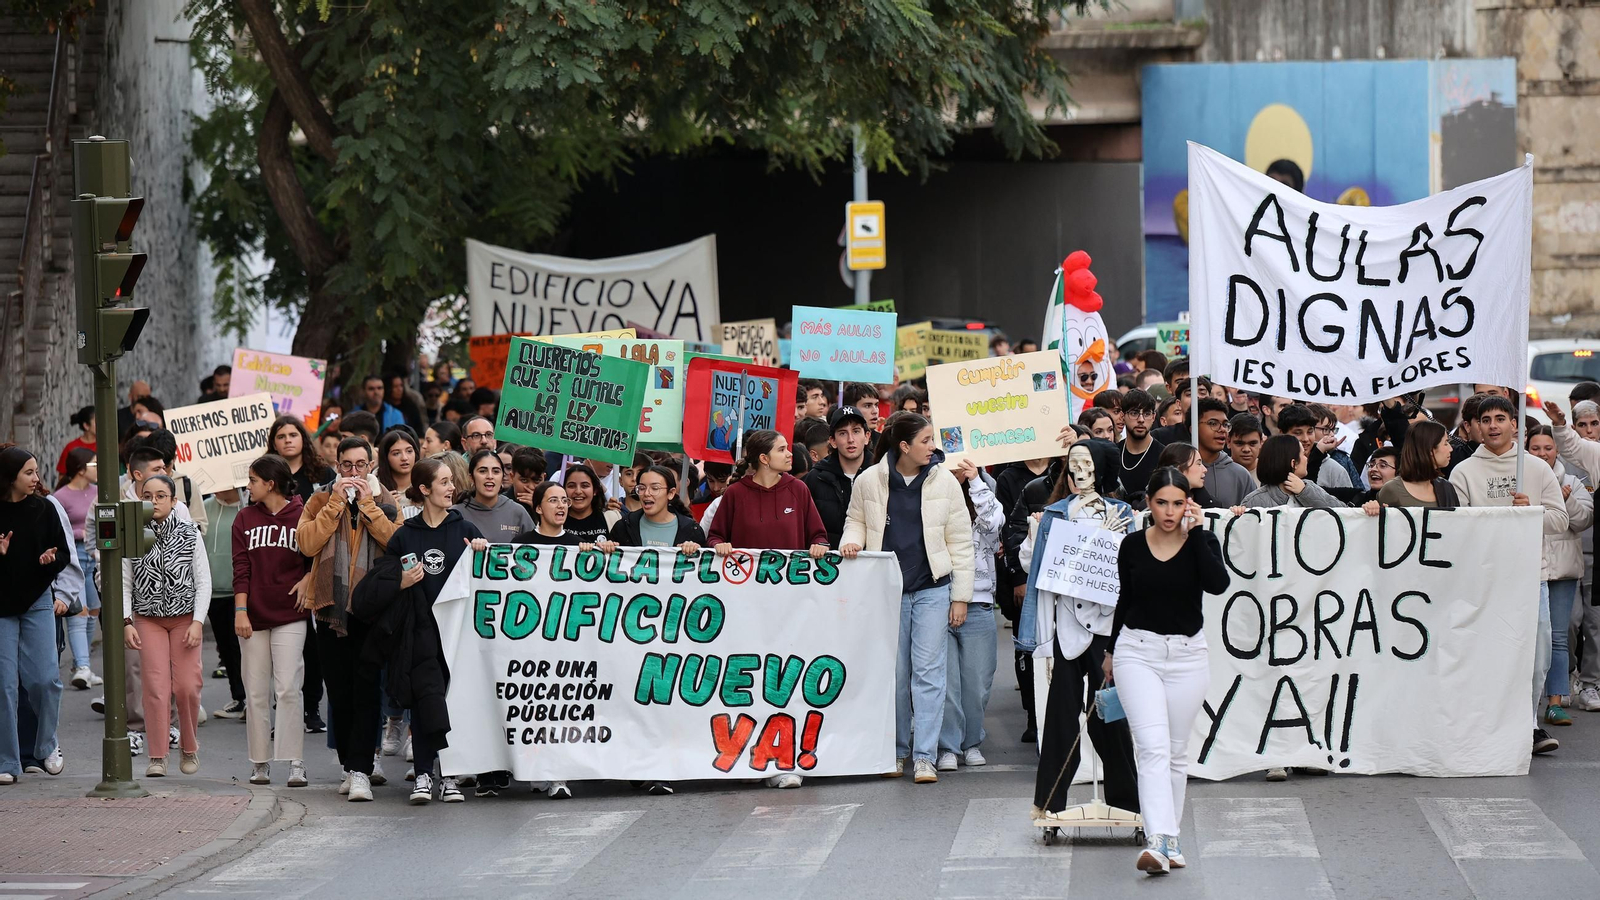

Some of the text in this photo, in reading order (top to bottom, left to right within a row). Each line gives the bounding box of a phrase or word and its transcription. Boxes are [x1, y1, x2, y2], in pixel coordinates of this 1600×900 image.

[1244, 193, 1487, 286] AULAS
[490, 262, 702, 341] EDIFICIO YA
[724, 325, 765, 341] EDIFICIO
[800, 318, 882, 338] MÁS AULAS
[1224, 274, 1474, 363] DIGNAS
[519, 342, 602, 377] QUEREMOS
[736, 339, 773, 357] NUEVO
[800, 349, 887, 365] NO JAULAS
[238, 353, 292, 376] Edificio
[1233, 347, 1471, 398] IES LOLA FLORES
[510, 365, 541, 389] QUE
[545, 372, 562, 393] SE
[571, 377, 625, 407] CUMPLE
[716, 374, 756, 395] NUEO
[170, 402, 269, 435] QUEREMOS AULAS
[534, 393, 598, 423] LA LEY
[197, 427, 271, 459] CONTENEDORE
[1062, 545, 1119, 565] ESPERAND
[1077, 534, 1119, 552] 14 AÑOS
[1204, 506, 1457, 579] CIO DE
[472, 544, 539, 582] IES
[548, 545, 662, 585] LOLA
[1053, 557, 1120, 580] LA EDUCACIO
[1047, 569, 1121, 595] EN LOS HUESO
[473, 589, 725, 645] EDIFICIO
[1221, 588, 1432, 666] OBRAS
[507, 659, 599, 679] POR UNA
[635, 653, 846, 708] NUEVO
[506, 700, 596, 723] PÚBLICA
[1196, 673, 1360, 769] YA!!
[503, 725, 613, 746] E CALIDAD
[710, 710, 824, 773] YA!
